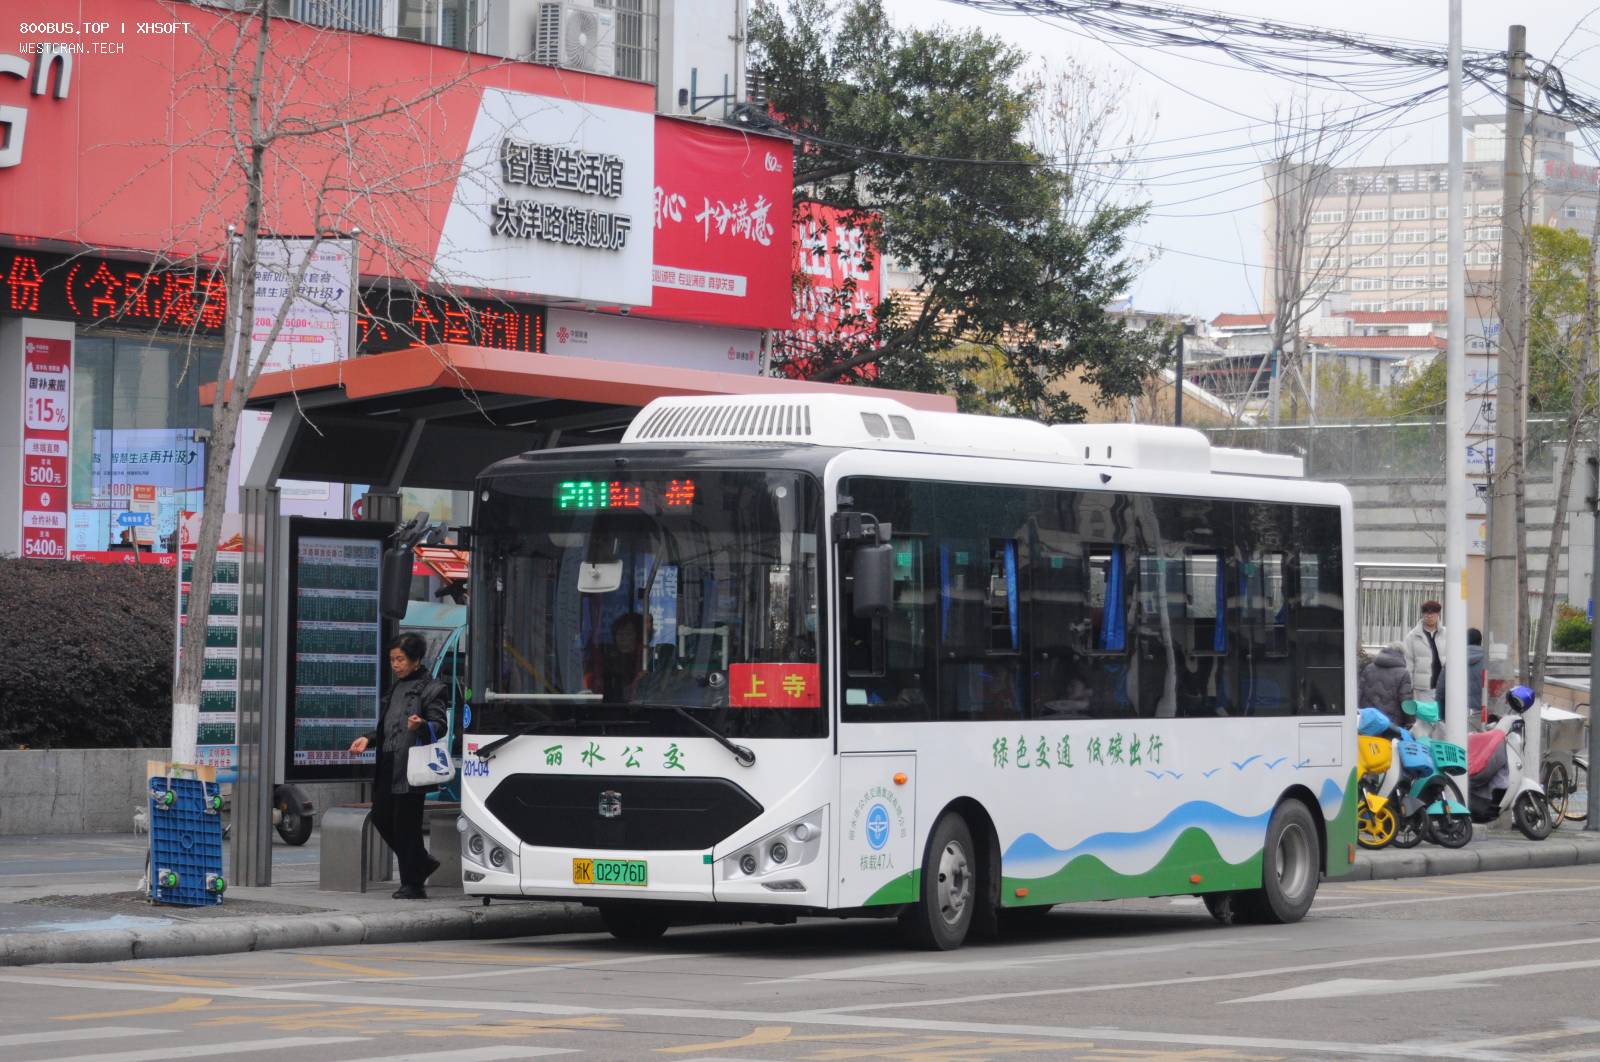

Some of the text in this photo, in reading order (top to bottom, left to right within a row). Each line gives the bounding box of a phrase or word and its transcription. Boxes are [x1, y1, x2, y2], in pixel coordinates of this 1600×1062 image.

[504, 140, 624, 198] 智慧生活馆
[494, 199, 632, 250] 大洋路旗舰厅
[799, 220, 870, 281] 出租
[30, 466, 62, 483] 500元
[25, 538, 64, 556] 5400元
[742, 672, 806, 699] 上寺
[542, 741, 686, 771] 丽水公交
[992, 732, 1164, 769] 绿色交通 低碳出行
[464, 759, 489, 776] 201-04
[596, 863, 646, 882] 02976D
